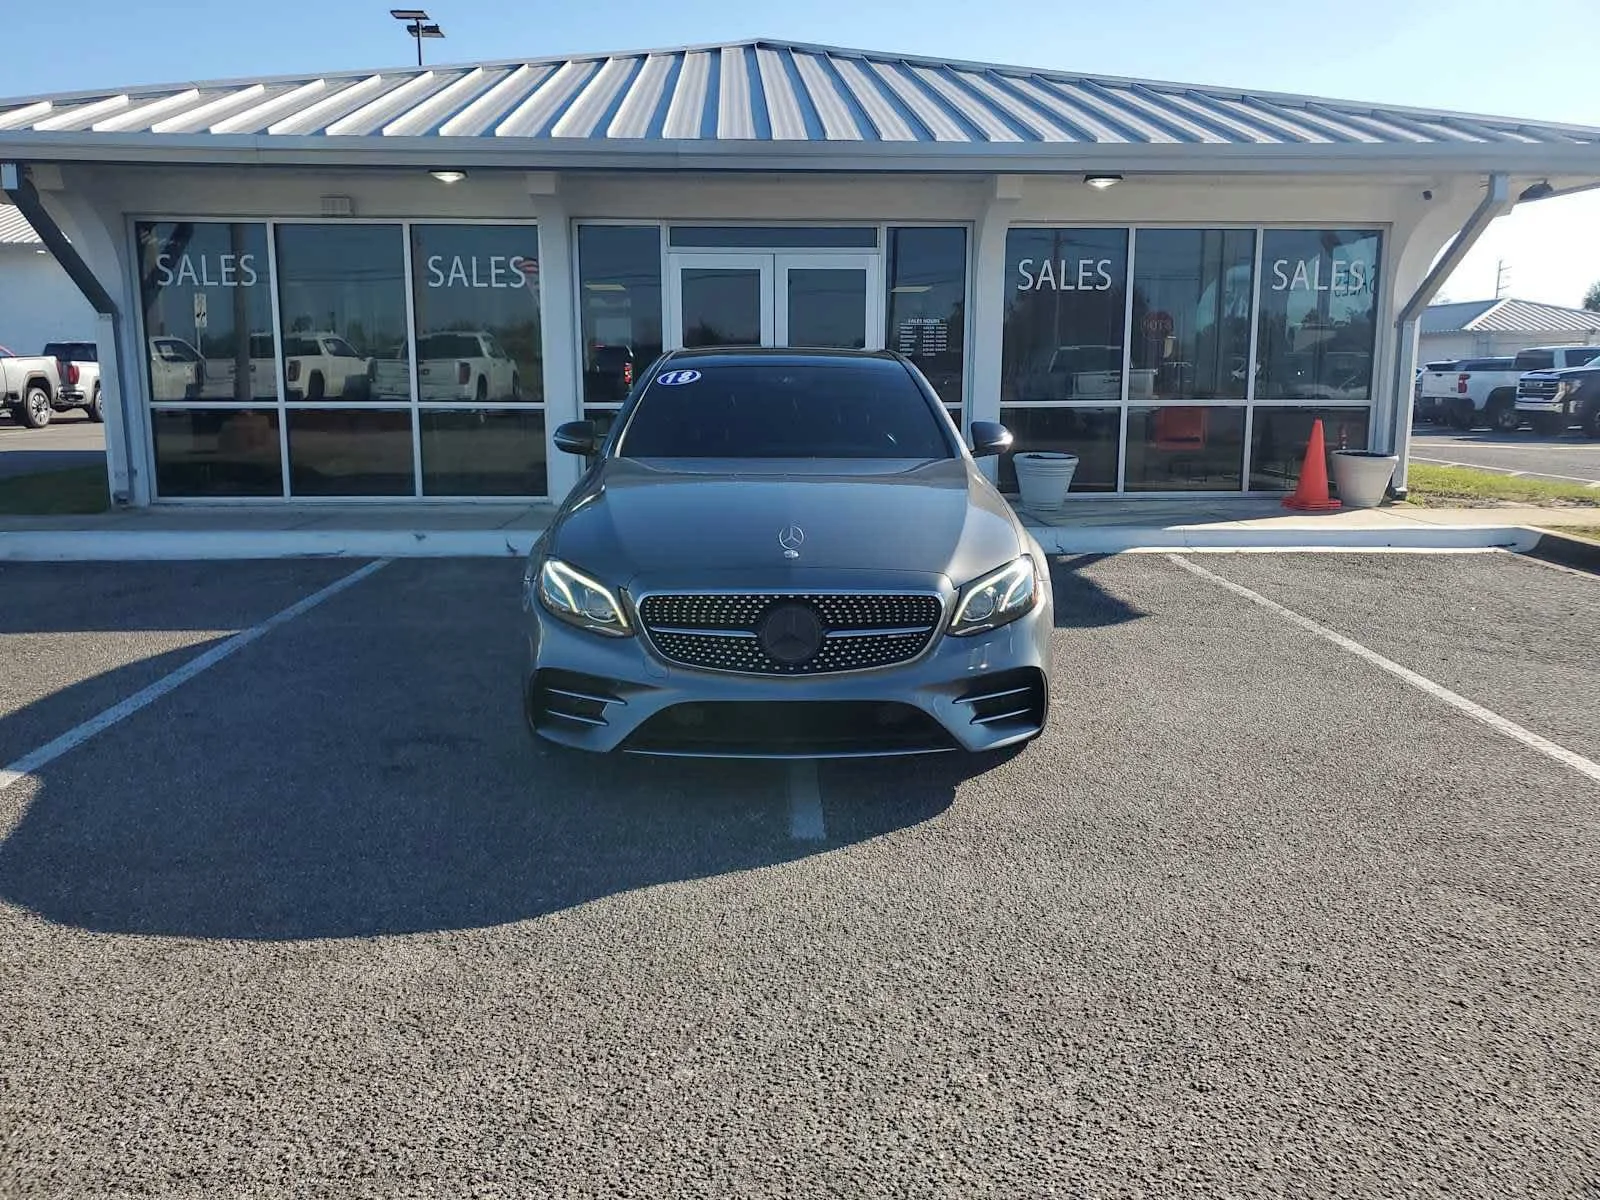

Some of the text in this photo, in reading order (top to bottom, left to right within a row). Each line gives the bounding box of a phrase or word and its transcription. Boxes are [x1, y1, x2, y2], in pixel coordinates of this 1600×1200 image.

[155, 253, 258, 287] SALES
[427, 255, 526, 288] SALES
[1017, 258, 1112, 291] SALES
[1271, 259, 1364, 291] SALES
[665, 371, 693, 384] 18
